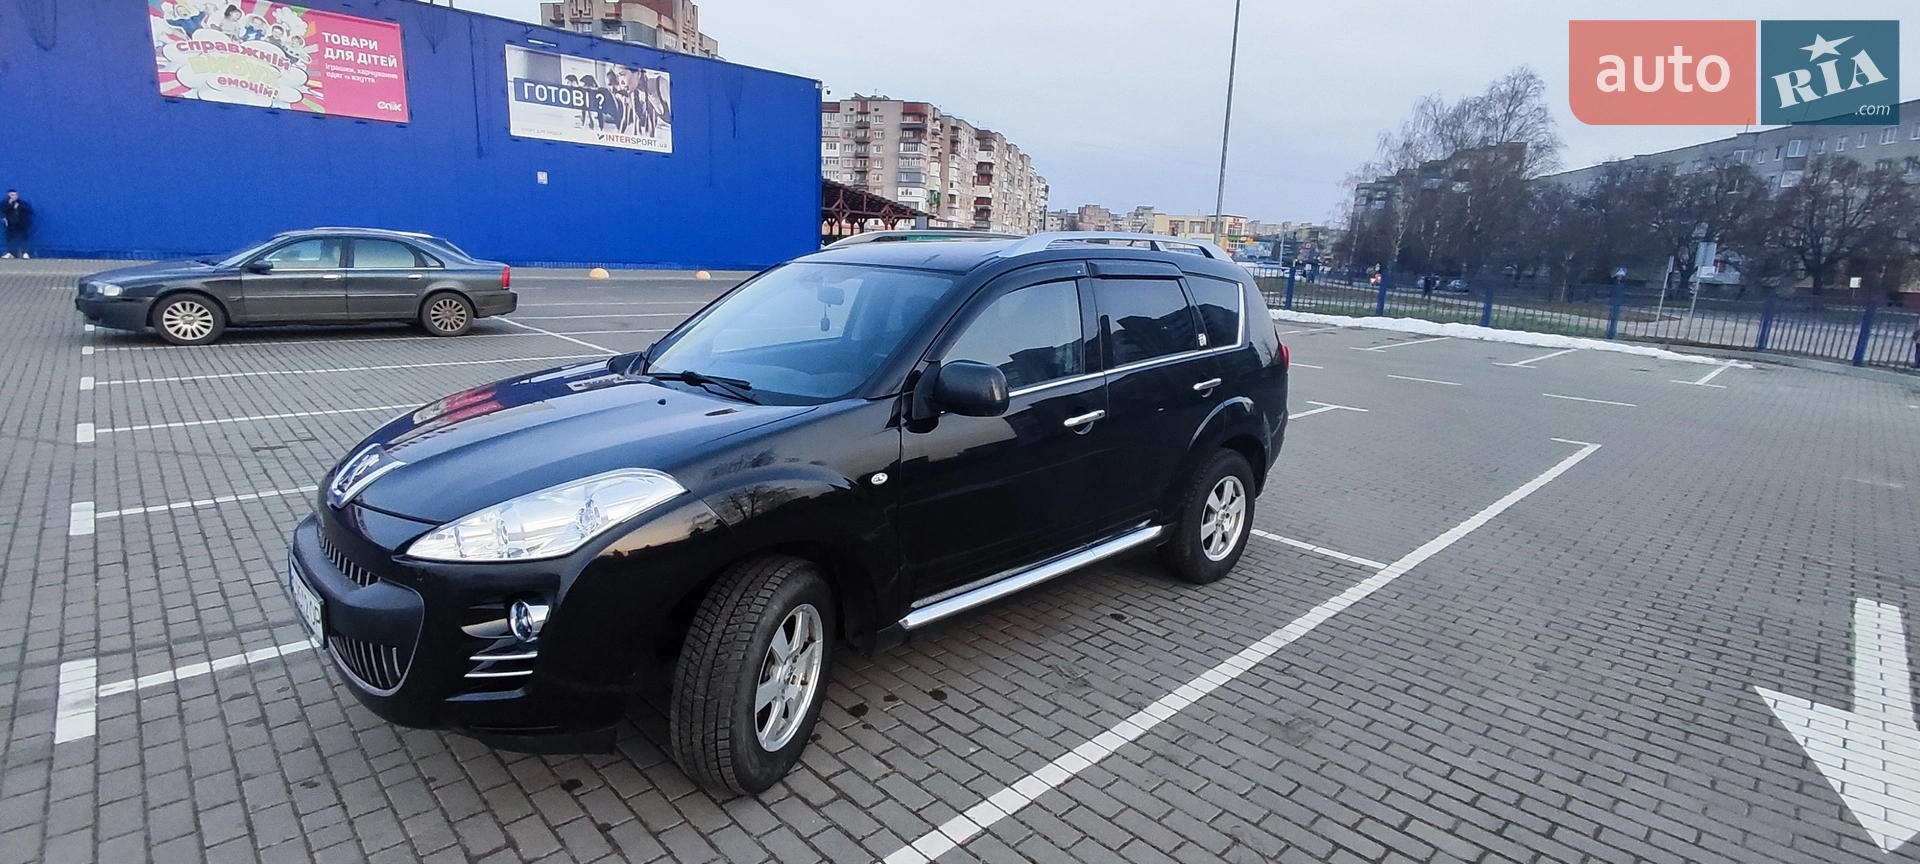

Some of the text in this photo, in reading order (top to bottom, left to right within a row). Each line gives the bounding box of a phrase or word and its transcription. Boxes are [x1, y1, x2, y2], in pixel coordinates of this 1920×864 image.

[322, 32, 378, 51] ТОВАРИ
[176, 41, 290, 71] справжній
[324, 48, 397, 68] ДЛЯ ДІТЕЙ
[217, 76, 279, 100] емоцій!
[523, 82, 605, 110] ГОТОВІ ?
[605, 133, 668, 149] INTERSPORT.ua
